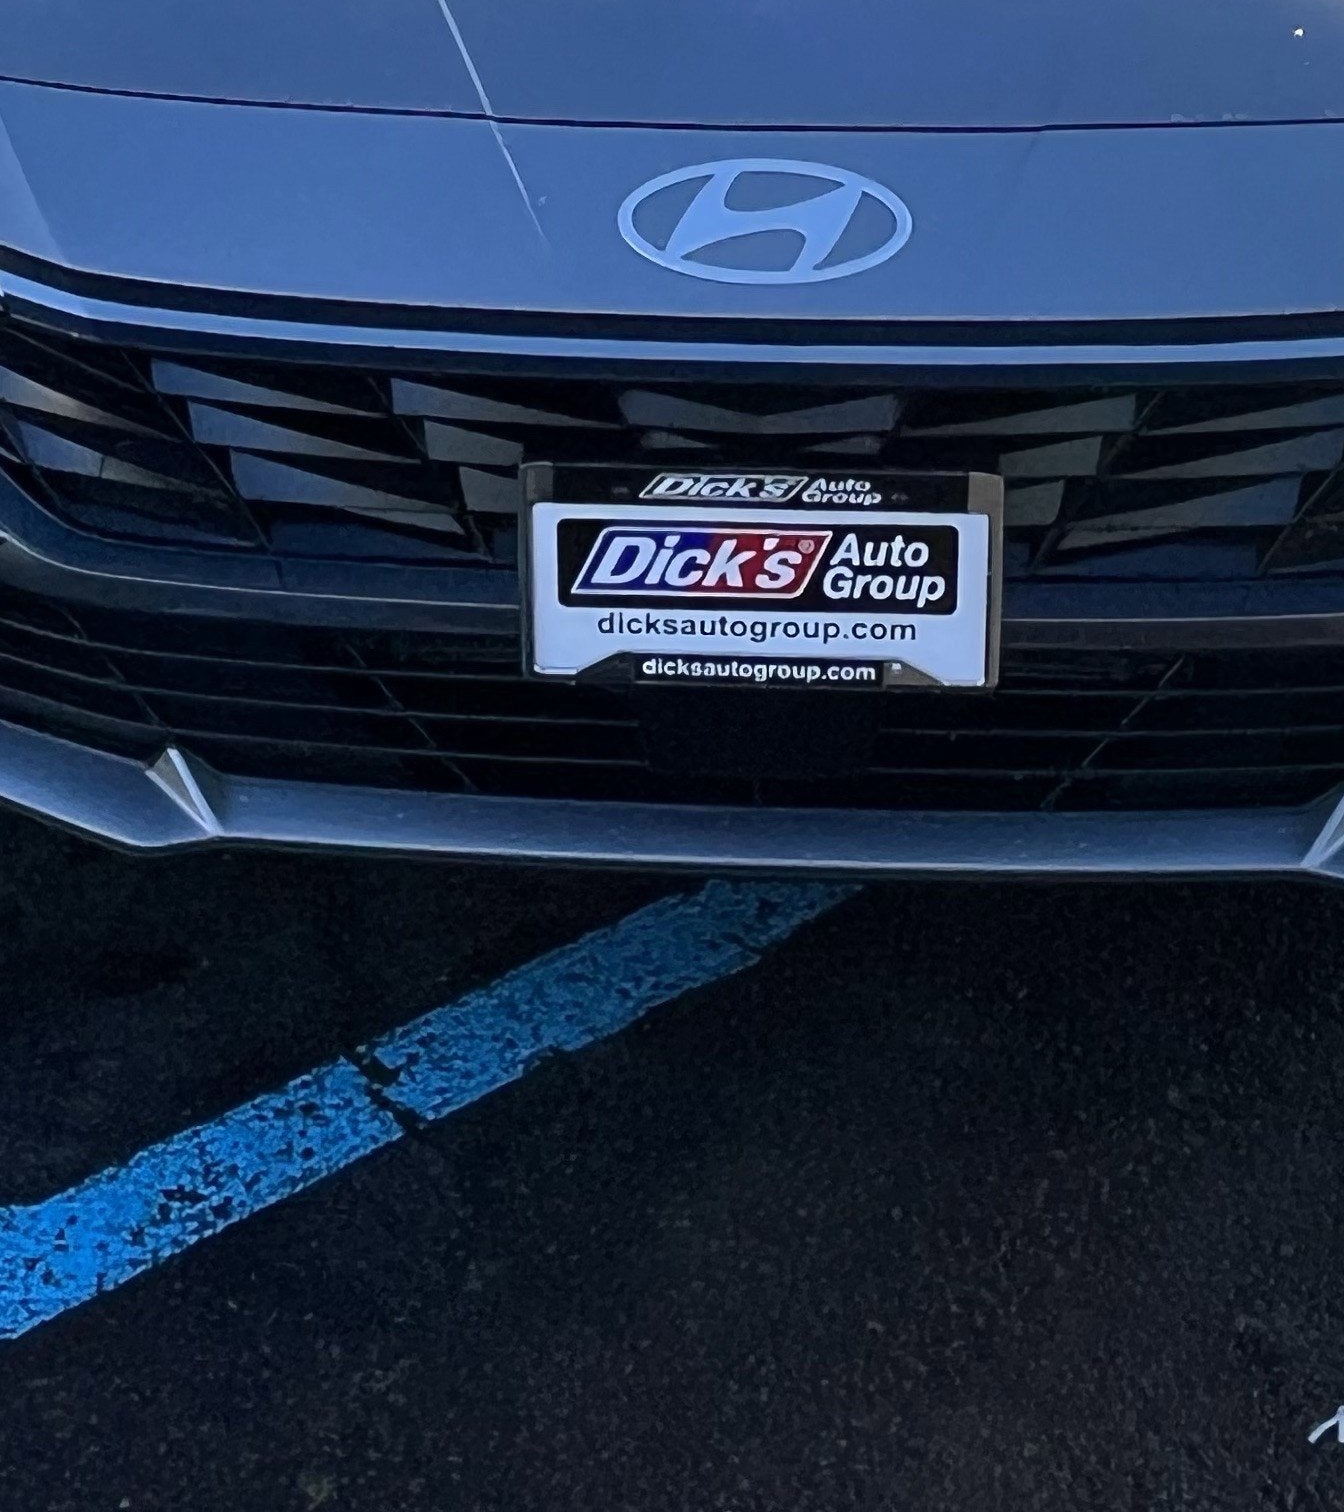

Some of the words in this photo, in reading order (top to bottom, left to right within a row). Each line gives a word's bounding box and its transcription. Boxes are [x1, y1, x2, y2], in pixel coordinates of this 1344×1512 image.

[801, 490, 882, 506] Group
[807, 477, 872, 492] Auto
[828, 533, 930, 568] Auto
[822, 567, 946, 609] Group
[596, 612, 917, 643] dicksautogroup.com
[641, 657, 877, 682] dicksautogroup.com
